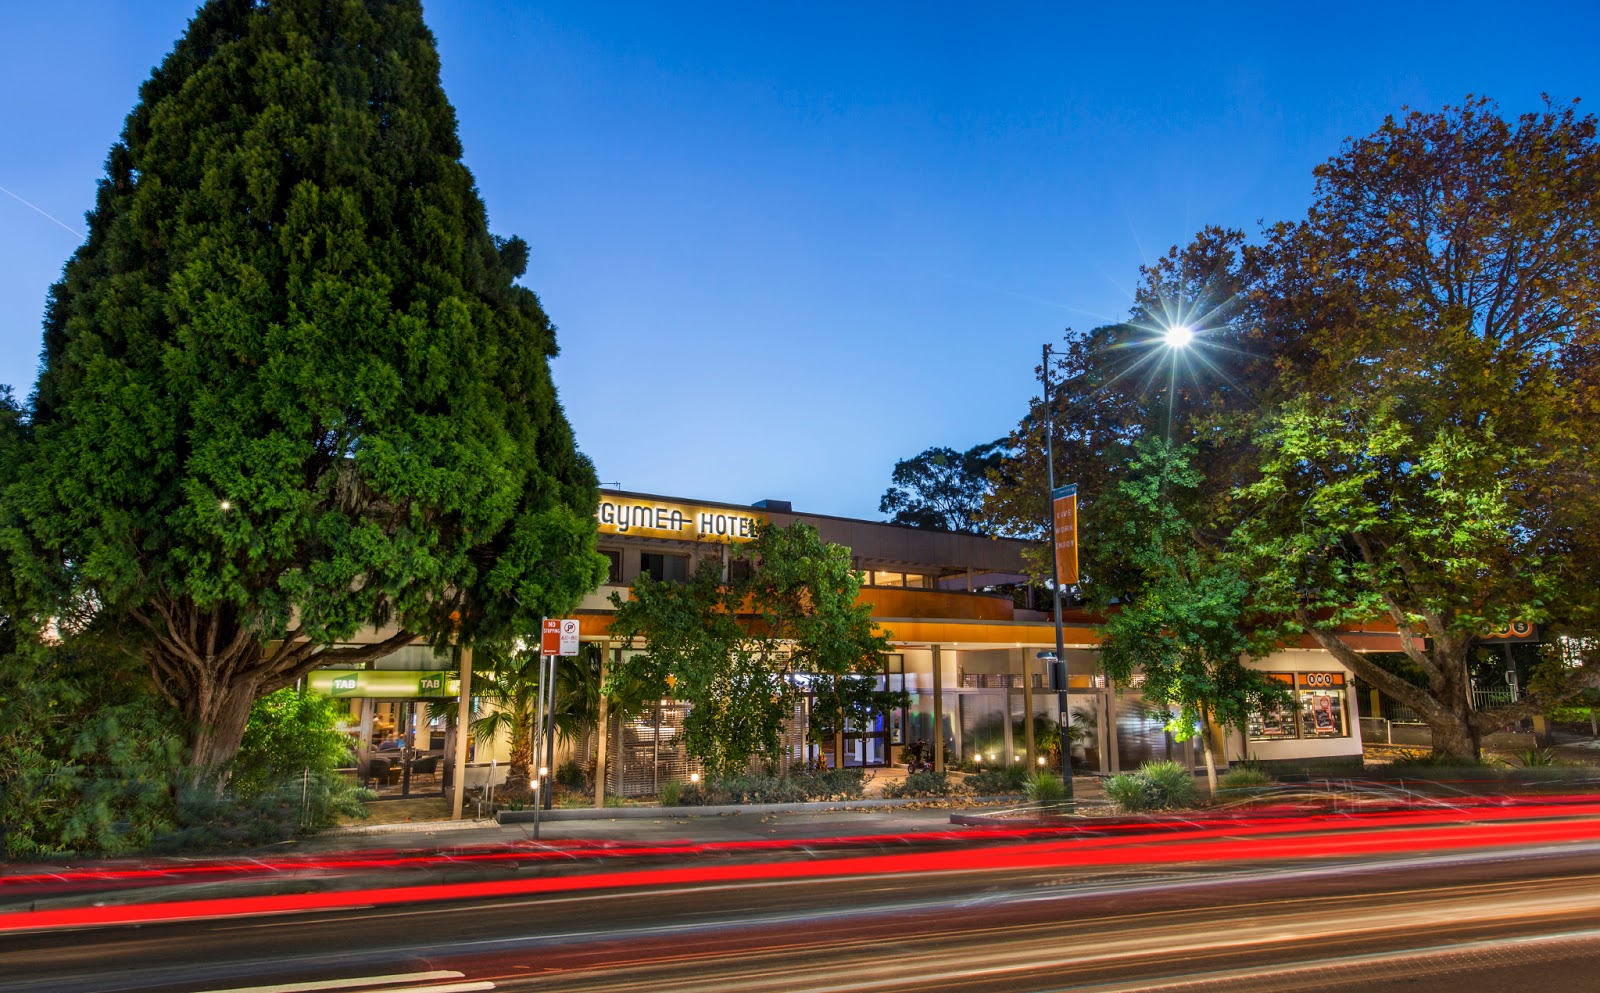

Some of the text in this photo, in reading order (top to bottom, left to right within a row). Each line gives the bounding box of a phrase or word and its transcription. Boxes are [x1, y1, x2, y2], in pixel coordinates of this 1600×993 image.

[1056, 509, 1072, 518] LIVE
[701, 513, 758, 538] HOTEL
[1055, 526, 1073, 535] WORK
[1056, 540, 1075, 550] ENJOY
[334, 679, 356, 689] TAB
[421, 679, 440, 689] TAB
